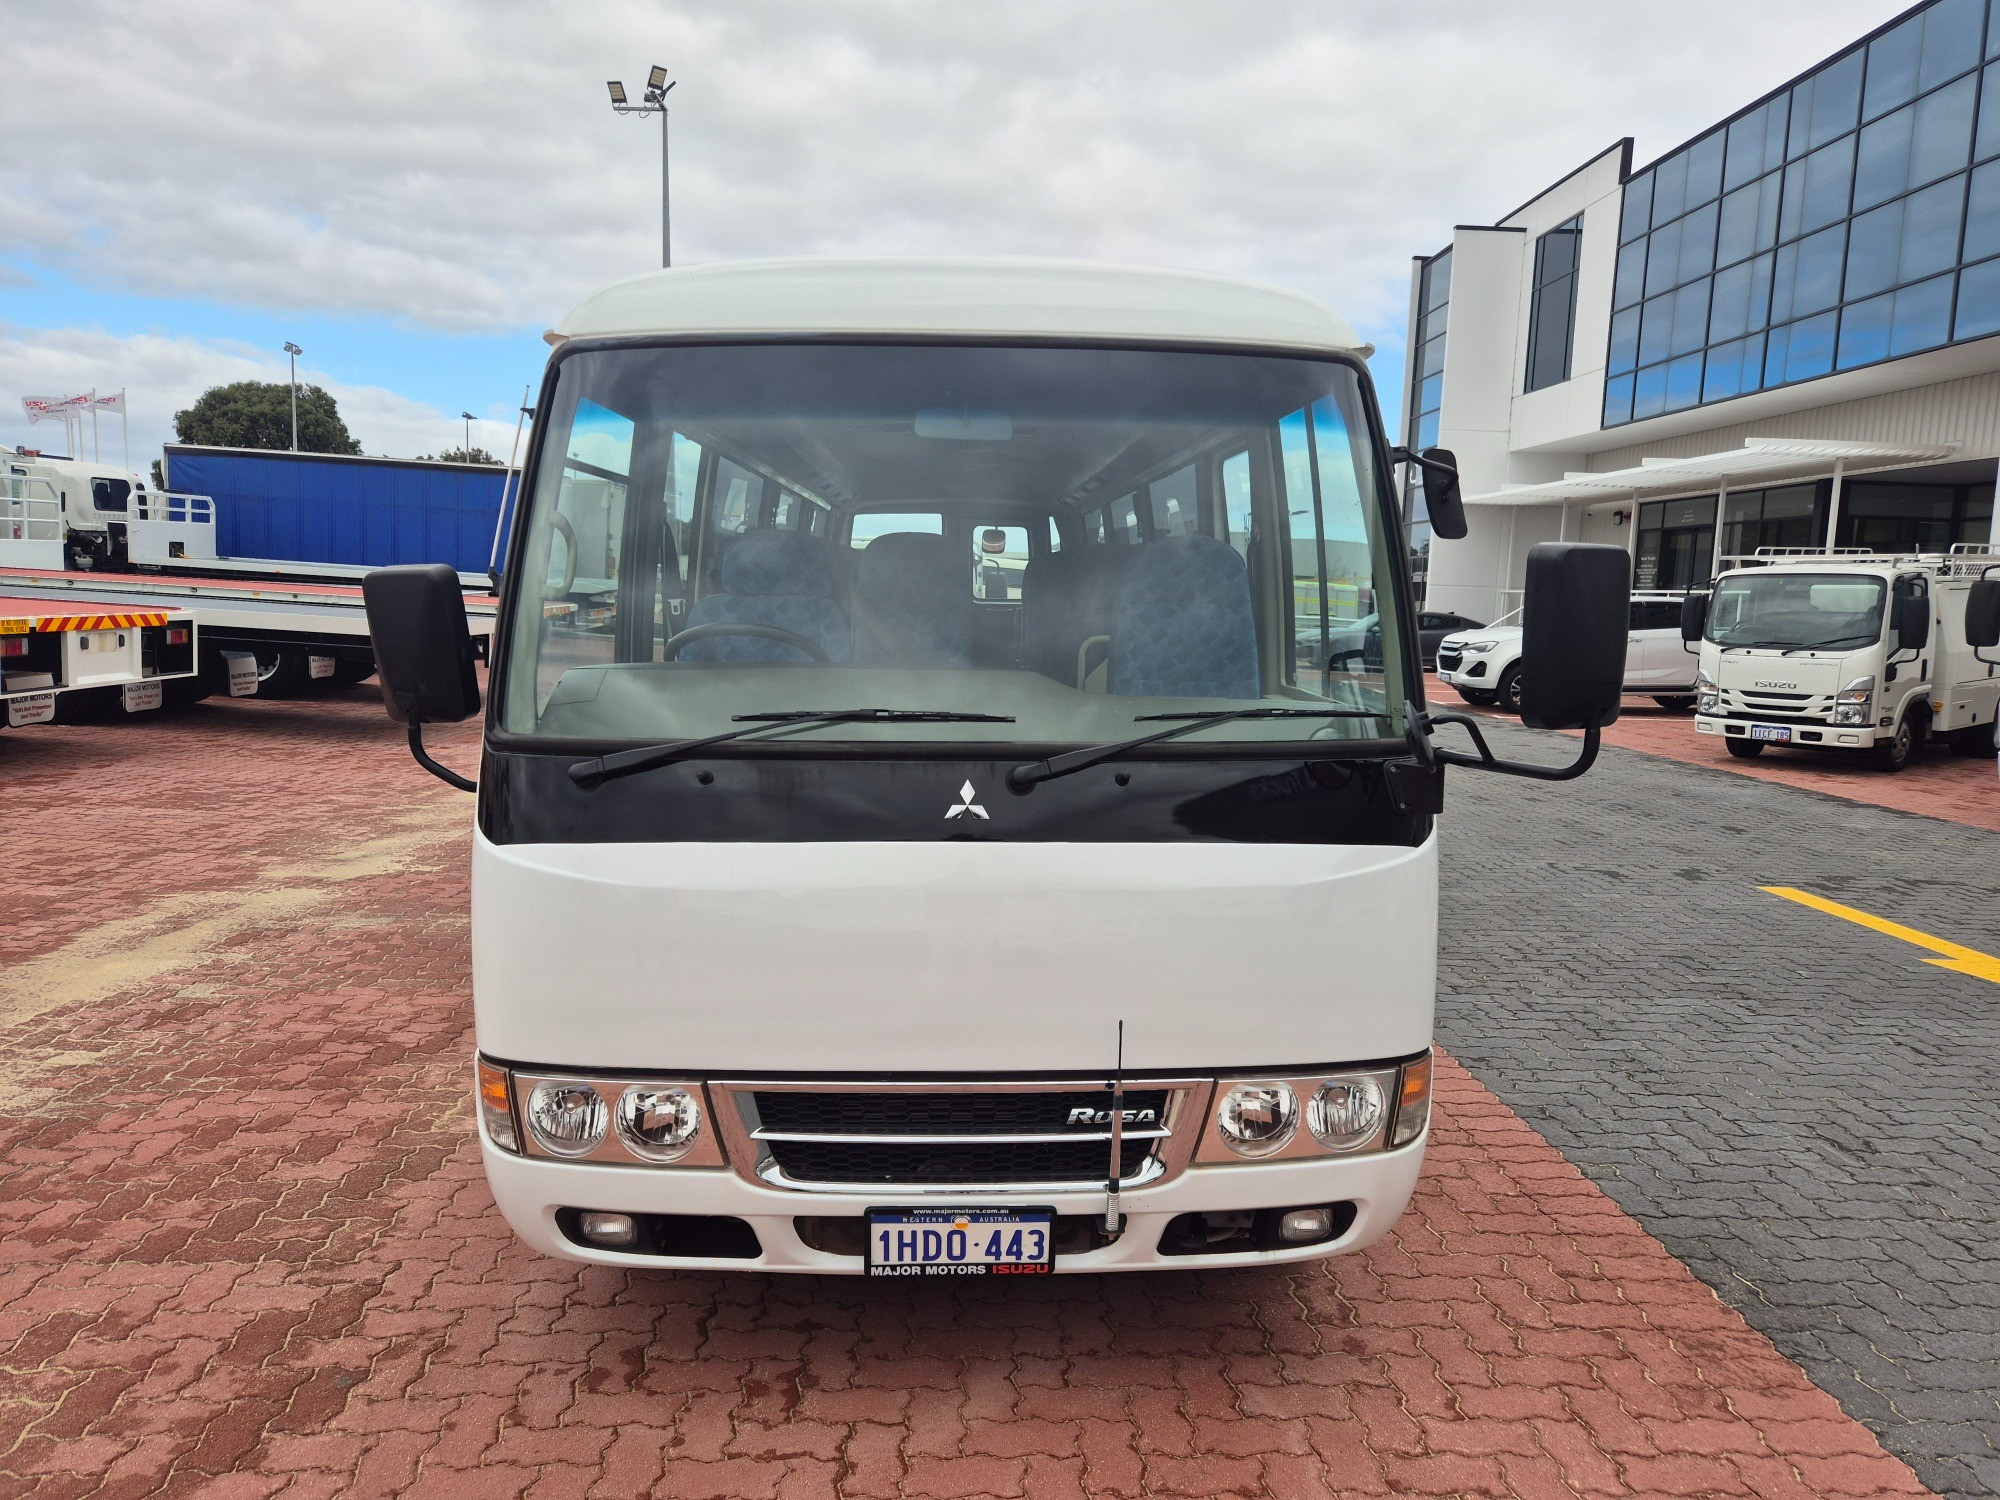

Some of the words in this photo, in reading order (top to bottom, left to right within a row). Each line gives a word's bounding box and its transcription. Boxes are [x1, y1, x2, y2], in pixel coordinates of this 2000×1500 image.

[1755, 680, 1797, 689] ISUZU
[10, 695, 29, 704] MAJOR
[30, 692, 53, 701] MOTORS
[913, 1208, 1009, 1216] www.majormotors.com.au
[870, 1266, 921, 1276] MAJOR
[925, 1265, 986, 1275] MOTORS
[992, 1264, 1048, 1274] ISUZU
